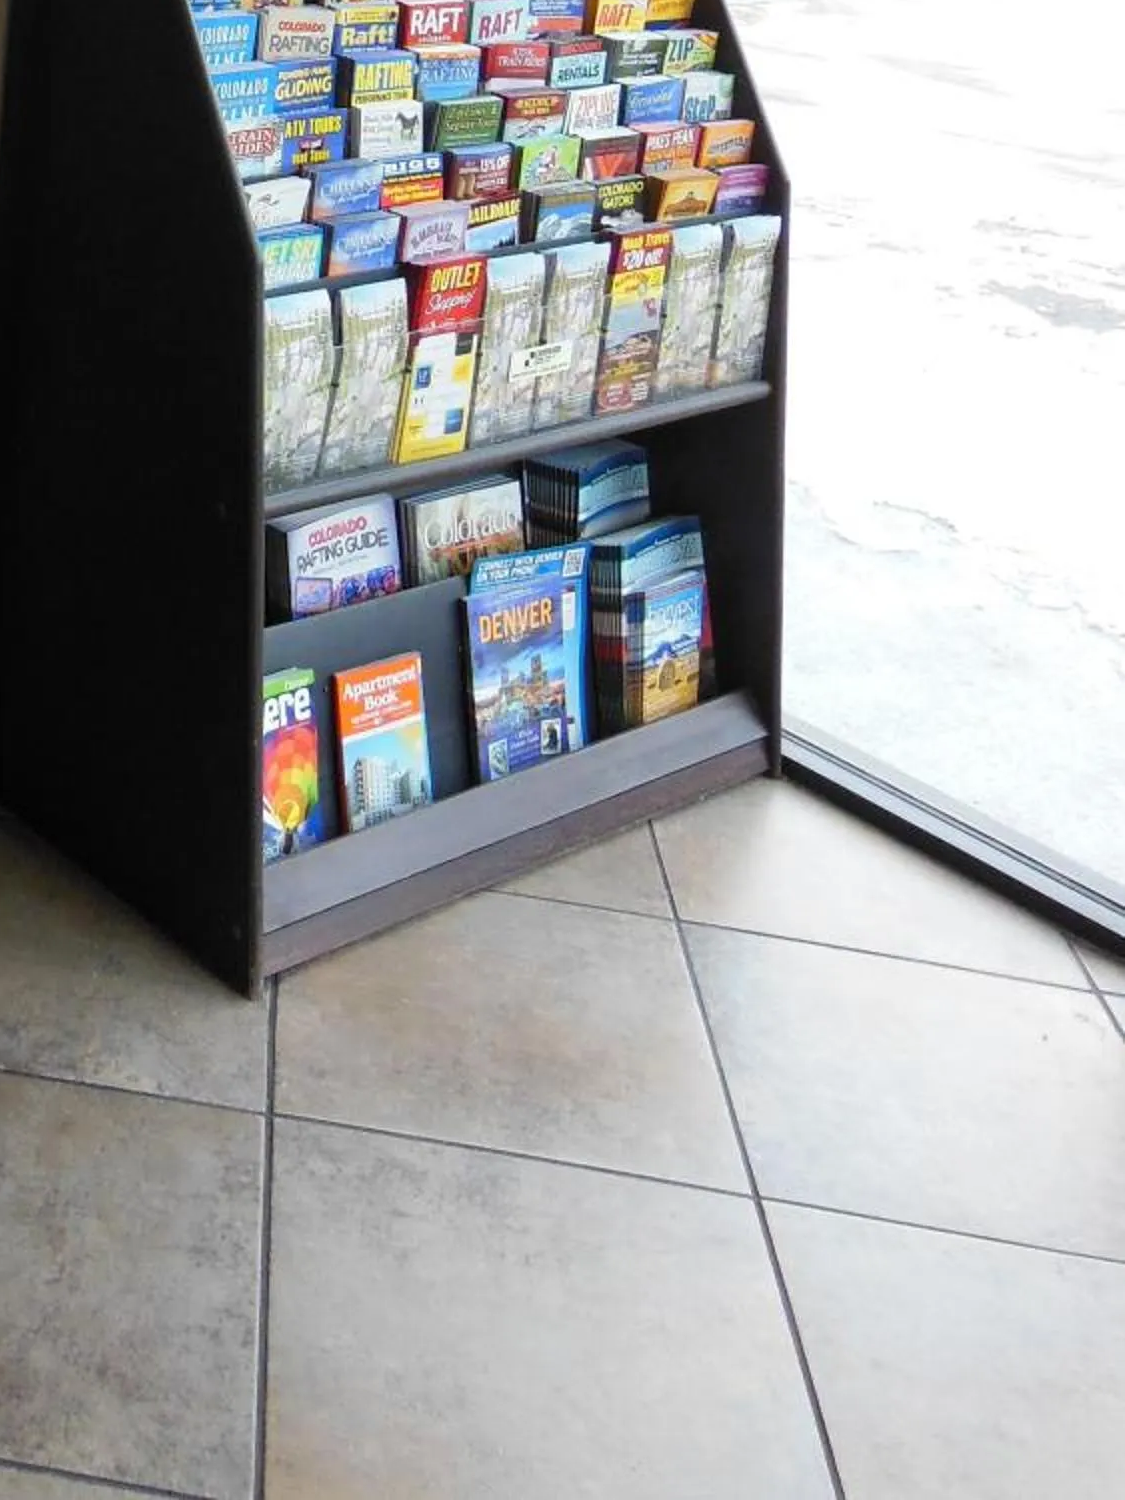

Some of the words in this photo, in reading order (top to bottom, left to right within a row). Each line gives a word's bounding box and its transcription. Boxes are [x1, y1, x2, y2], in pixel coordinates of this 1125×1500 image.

[278, 19, 326, 33] COLORADO
[411, 7, 464, 36] RAFT
[478, 8, 524, 41] RAFT
[598, 3, 635, 27] RAFT
[268, 35, 330, 55] RAFTING
[341, 24, 393, 47] Raft!
[668, 36, 694, 63] ZIP
[355, 62, 413, 90] RAFTING
[421, 66, 475, 84] RAFTING
[557, 63, 600, 82] RENTALS
[274, 76, 333, 101] GLIDING
[229, 130, 273, 145] TRAIN
[284, 119, 306, 139] ATV
[309, 115, 343, 135] TOURS
[598, 181, 644, 198] COLORADO
[431, 262, 482, 293] OUTLET
[308, 515, 368, 548] COLORADO
[424, 508, 520, 550] Colorado
[296, 542, 344, 574] RAFTING
[345, 527, 390, 559] GUIDE
[478, 597, 554, 644] DENVER
[343, 665, 416, 702] Apartment
[263, 687, 312, 732] ere
[364, 689, 400, 711] Book
